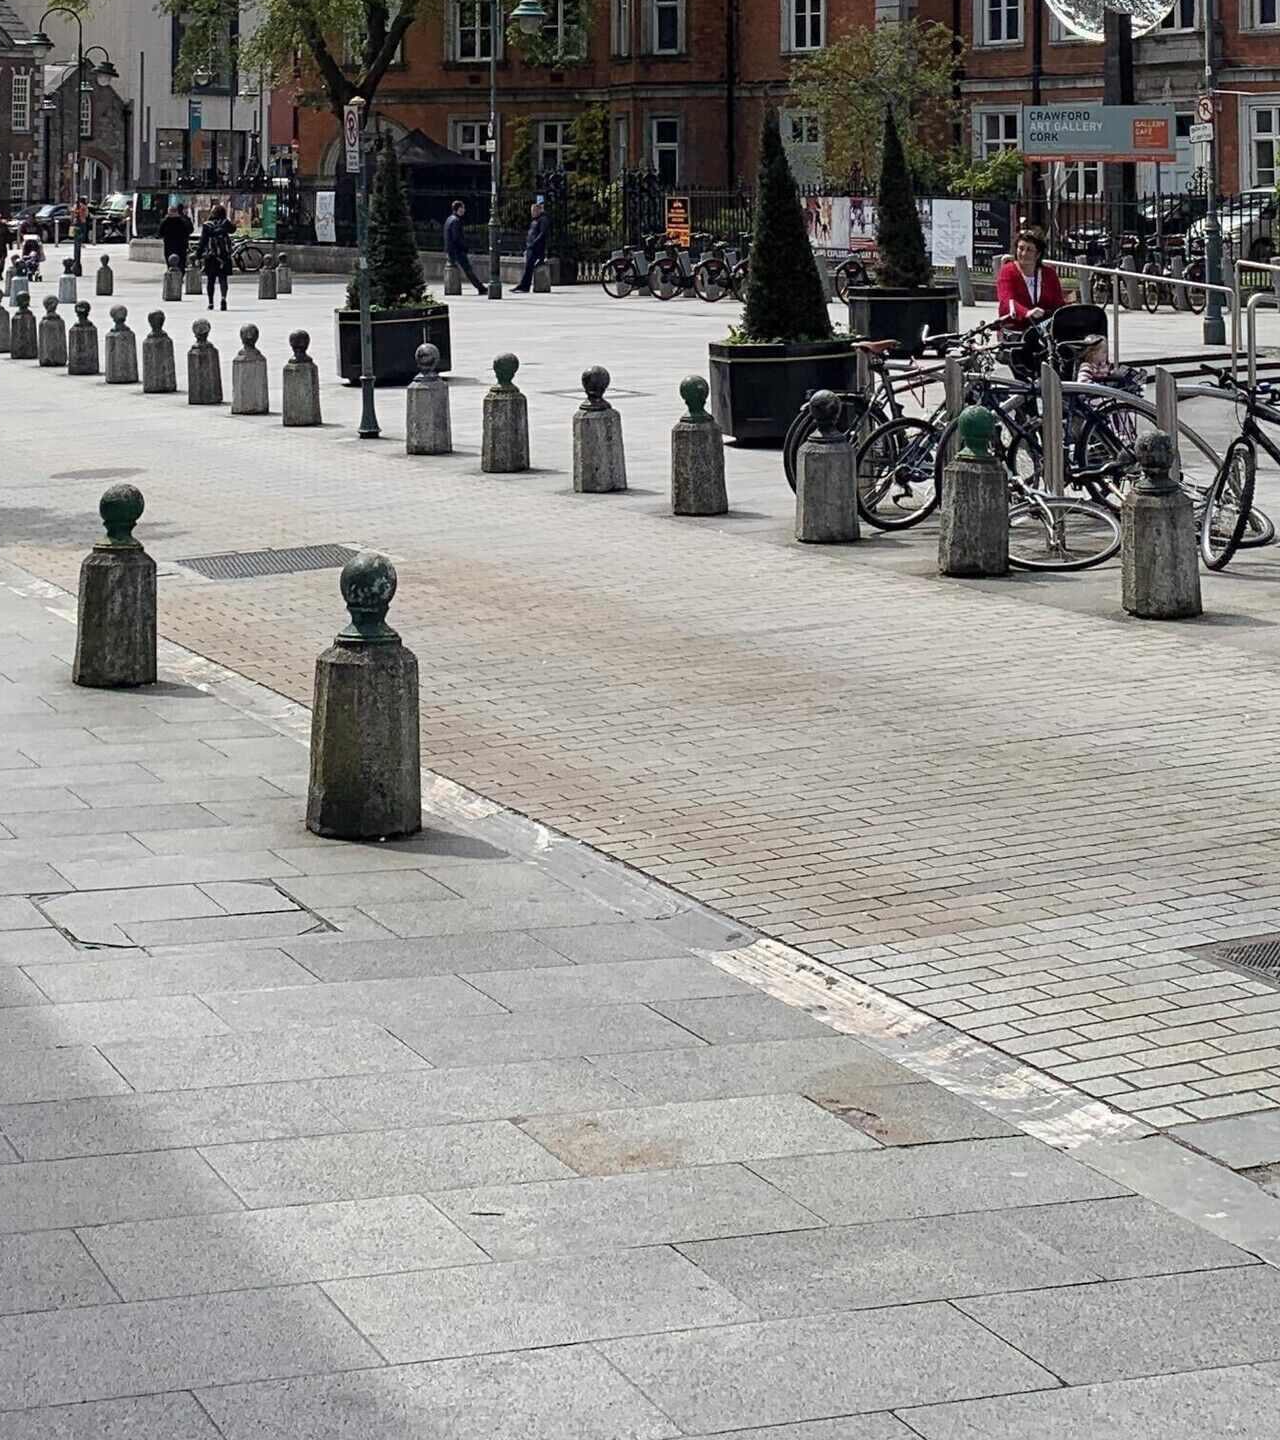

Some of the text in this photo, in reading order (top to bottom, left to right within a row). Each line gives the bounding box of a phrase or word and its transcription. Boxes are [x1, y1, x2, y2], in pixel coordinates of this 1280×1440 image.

[1029, 111, 1090, 121] CRAWFORD
[1029, 122, 1104, 132] ART GALLERY
[1030, 132, 1059, 142] CORK
